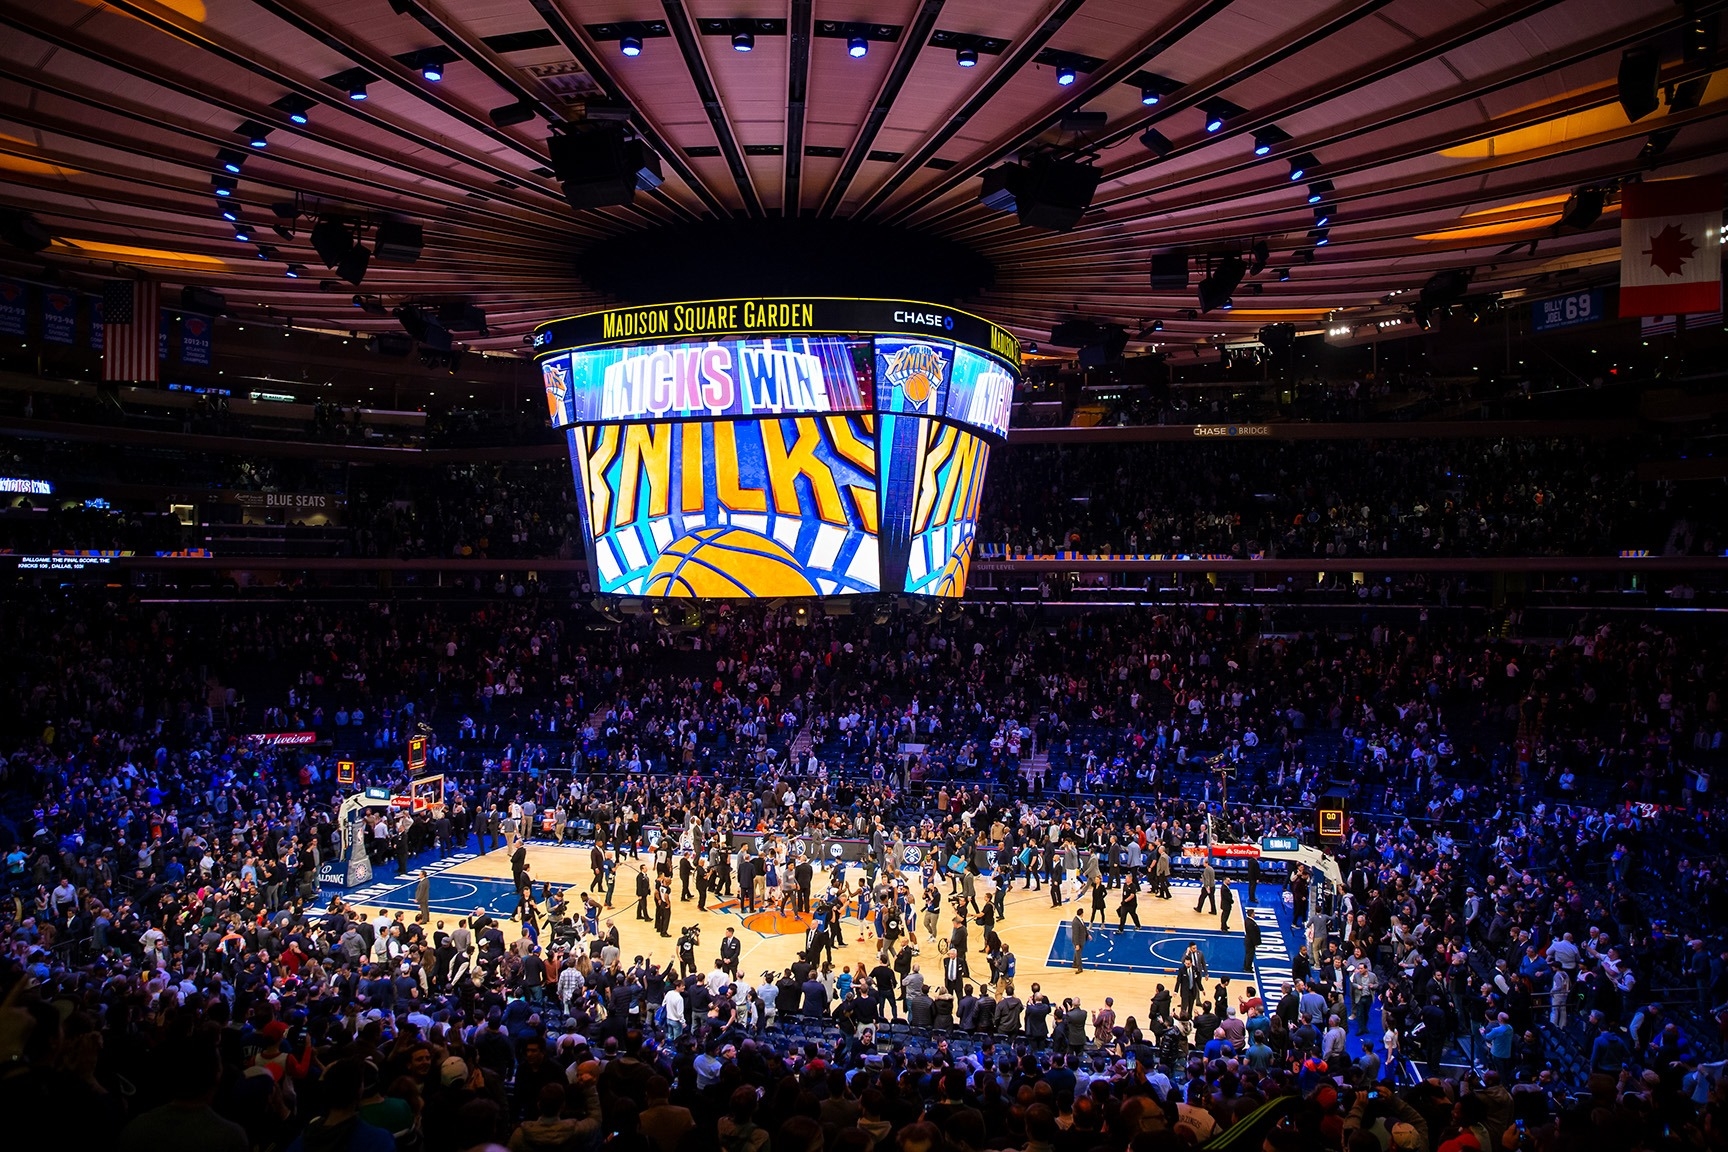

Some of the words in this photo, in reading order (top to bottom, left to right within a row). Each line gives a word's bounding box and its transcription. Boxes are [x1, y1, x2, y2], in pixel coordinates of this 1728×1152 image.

[1544, 299, 1563, 313] BILLY
[1565, 294, 1591, 320] 69
[603, 310, 668, 339] MADISON
[674, 305, 738, 332] SQUARE
[744, 301, 813, 329] GARDEN
[893, 311, 943, 327] CHASE
[1545, 312, 1563, 324] JOEL
[890, 350, 942, 380] KNICKS
[601, 346, 735, 419] KNICKS
[1238, 426, 1268, 435] BRIDGE
[267, 494, 293, 506] BLUE
[296, 495, 326, 507] SEATS
[318, 873, 344, 885] ALDING
